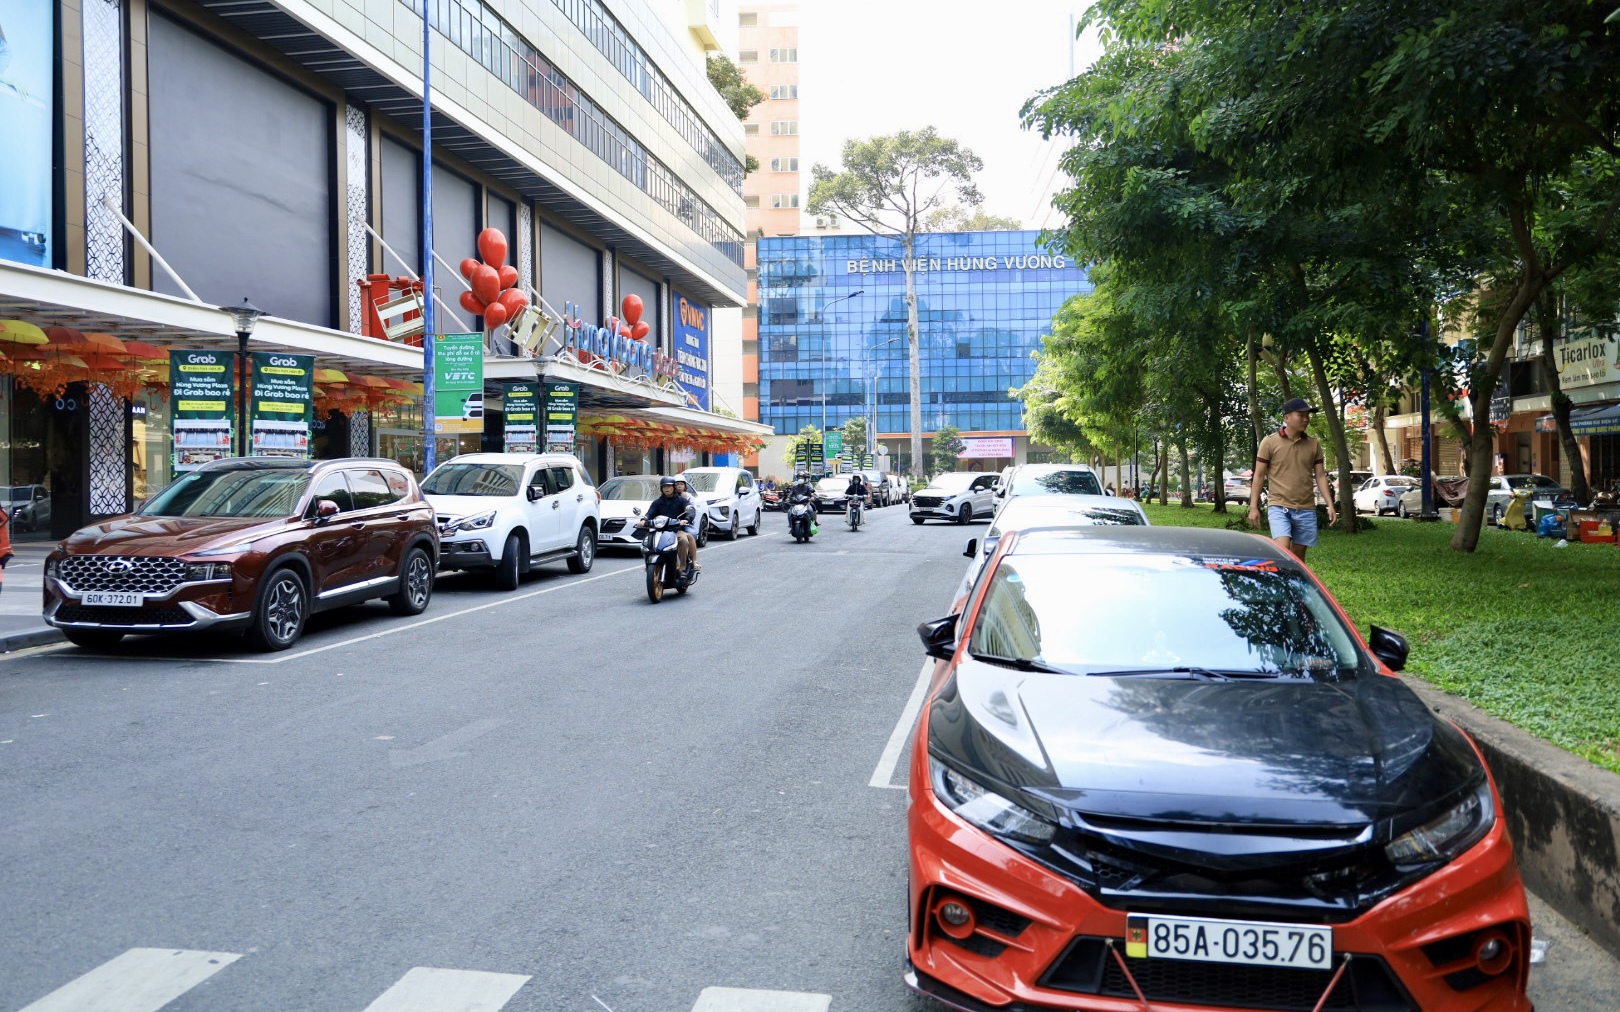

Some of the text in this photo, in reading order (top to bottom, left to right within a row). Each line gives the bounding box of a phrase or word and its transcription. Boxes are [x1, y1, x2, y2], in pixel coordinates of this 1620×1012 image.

[847, 256, 896, 275] BỆNH
[947, 254, 997, 271] HÙNG
[1003, 254, 1066, 270] VƯƠNG
[1560, 342, 1606, 364] Ticarlox
[188, 354, 216, 364] Grab
[270, 356, 297, 367] Grab
[444, 372, 475, 380] VETC
[222, 388, 231, 396] rẻ
[264, 390, 284, 398] Grab
[284, 391, 301, 399] bao
[301, 392, 310, 400] rẻ
[1205, 563, 1279, 573] RACING
[86, 594, 137, 604] 60K-372.01
[1153, 922, 1326, 964] 85A-035.76
